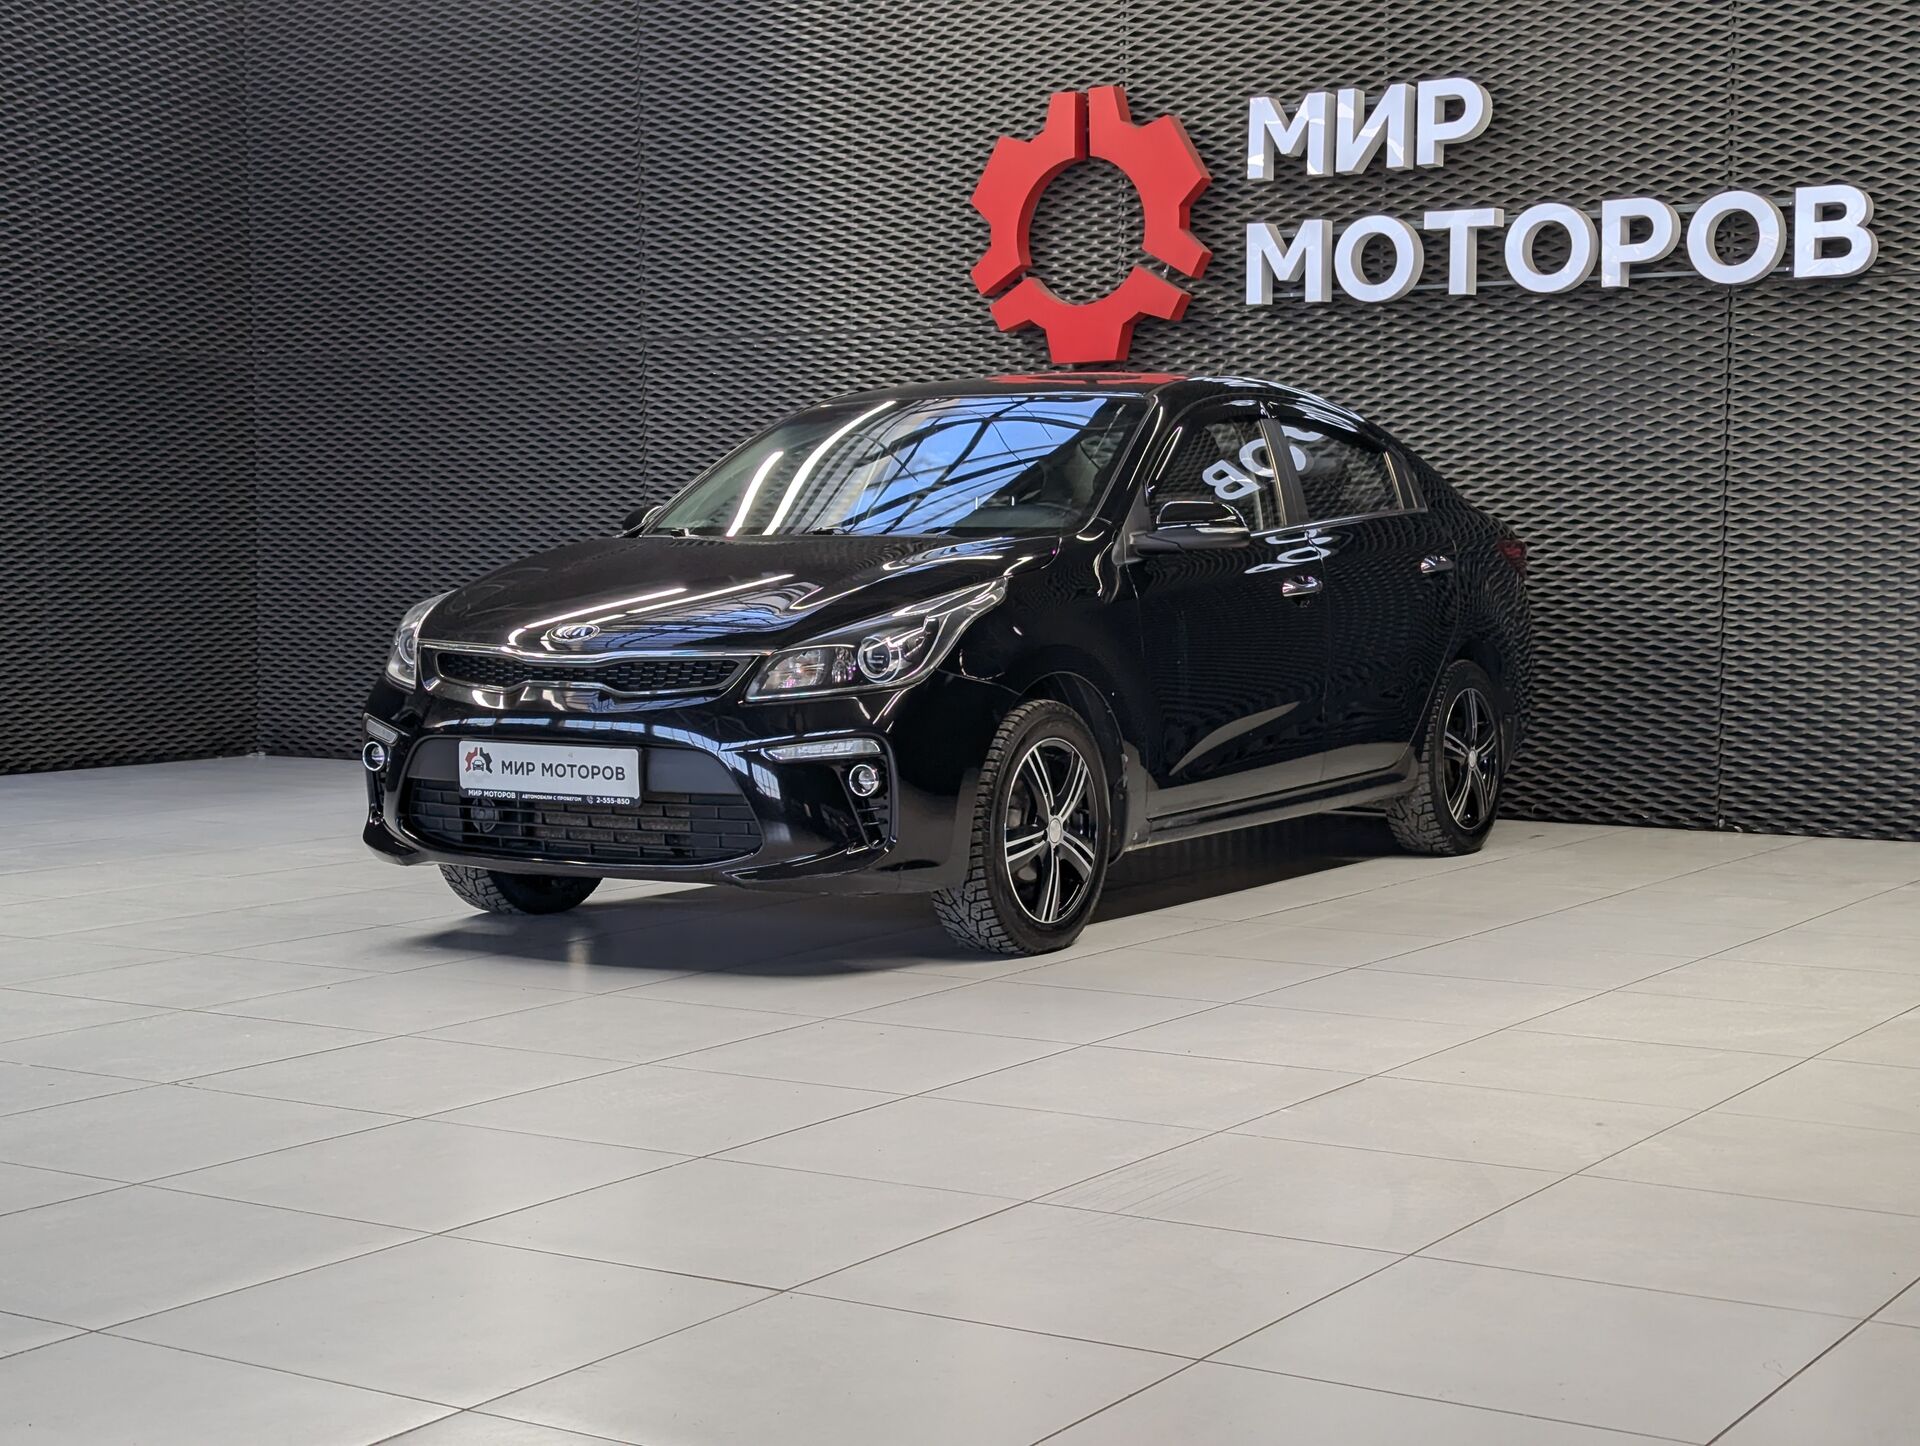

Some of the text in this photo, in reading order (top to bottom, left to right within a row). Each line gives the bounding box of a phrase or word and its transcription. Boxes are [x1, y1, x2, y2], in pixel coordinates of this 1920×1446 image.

[1246, 77, 1493, 181] МИР
[1245, 184, 1879, 306] МОТОРОВ
[468, 789, 482, 797] МИР
[483, 790, 516, 799] МОТОРОВ
[521, 793, 552, 801] АВТОМОБИЛИ
[596, 797, 630, 805] 2-555-850
[501, 760, 626, 781] МИР МОТОРОВ
